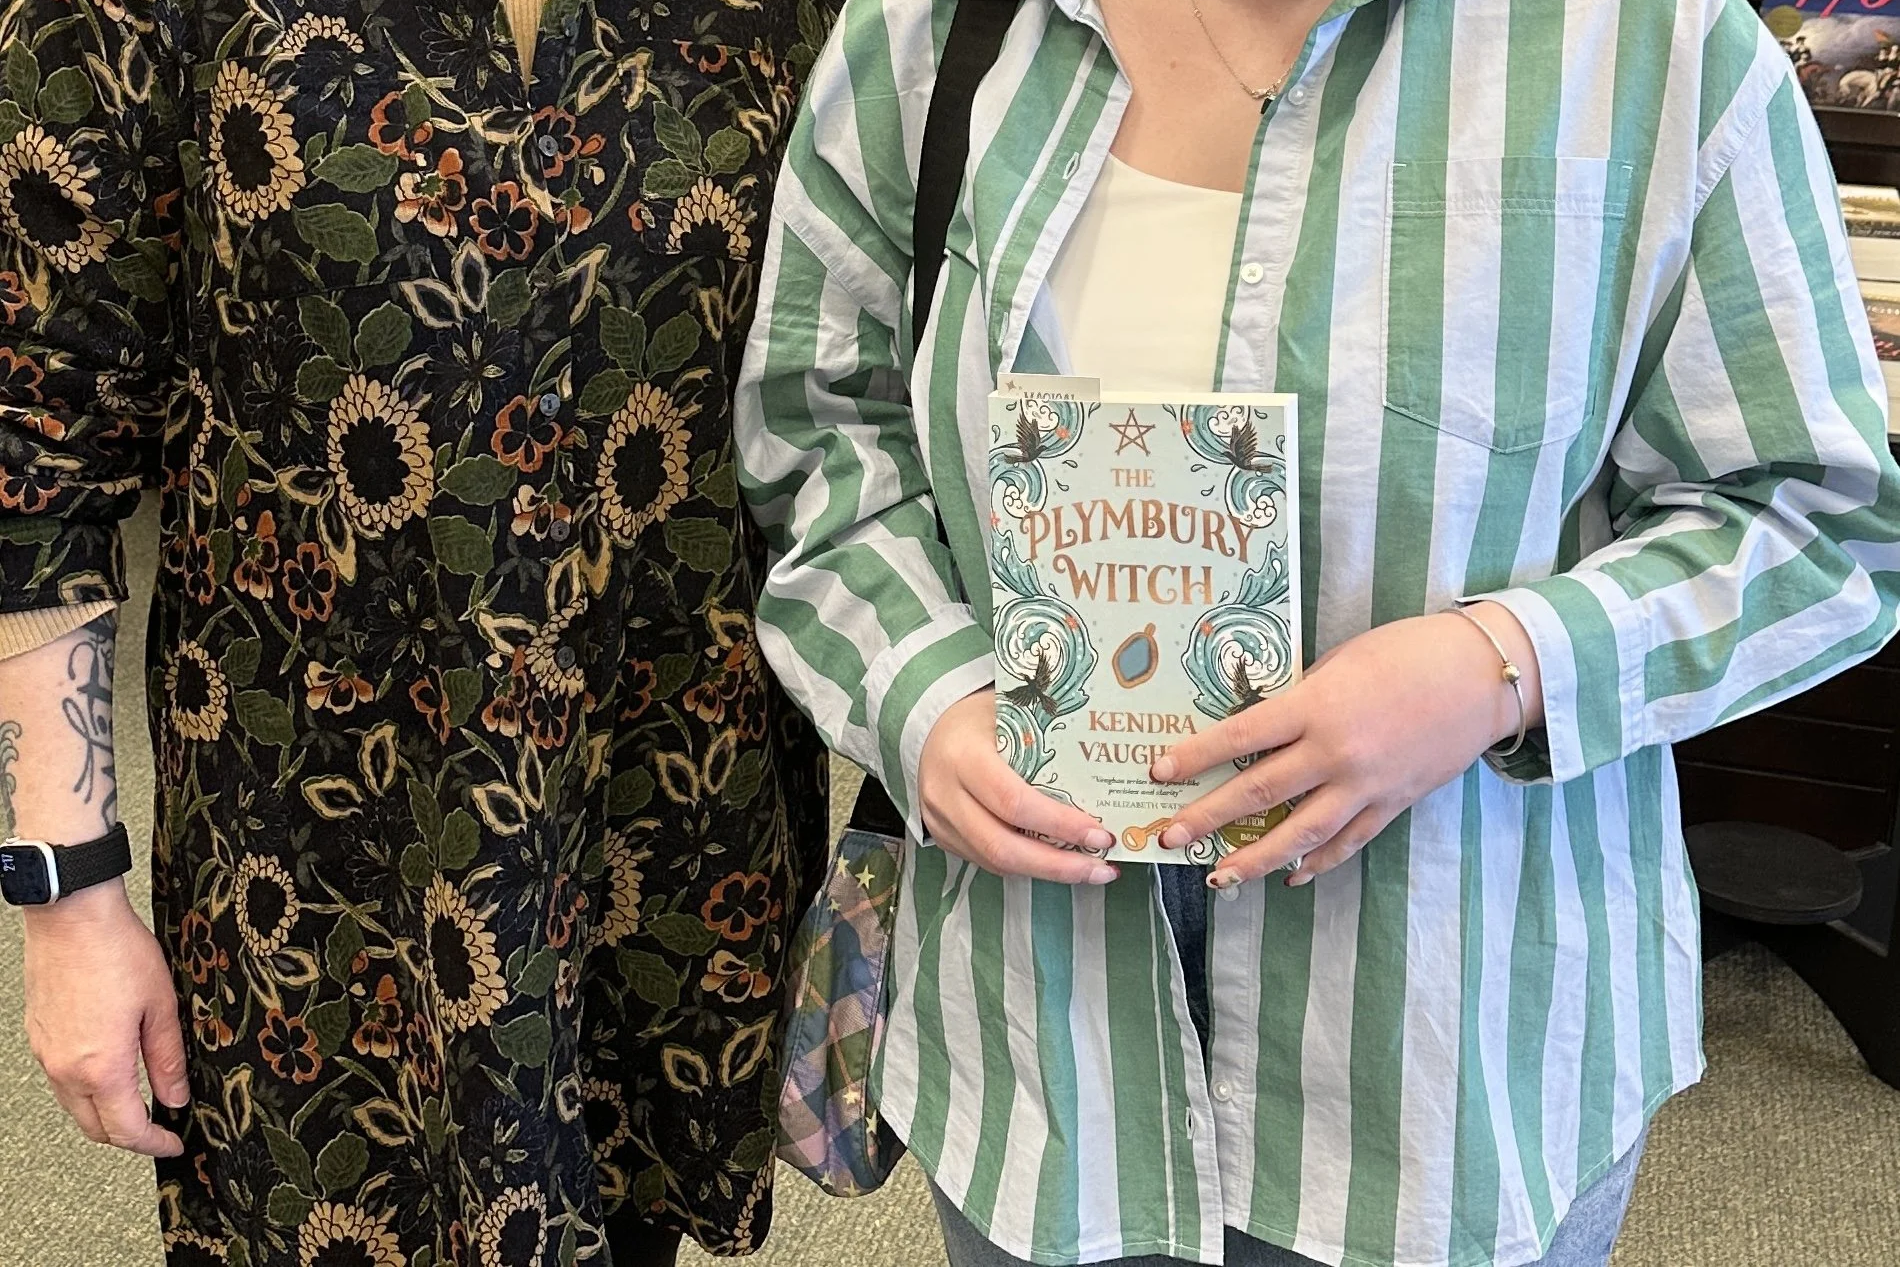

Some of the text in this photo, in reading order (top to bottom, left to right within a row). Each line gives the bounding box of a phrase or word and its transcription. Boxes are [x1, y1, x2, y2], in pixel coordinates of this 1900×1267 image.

[1110, 467, 1156, 489] THE
[1020, 498, 1257, 564] PLYMBURY
[1053, 554, 1214, 606] WITCH
[1088, 710, 1198, 735] KENDRA
[1078, 741, 1168, 766] VAUGH
